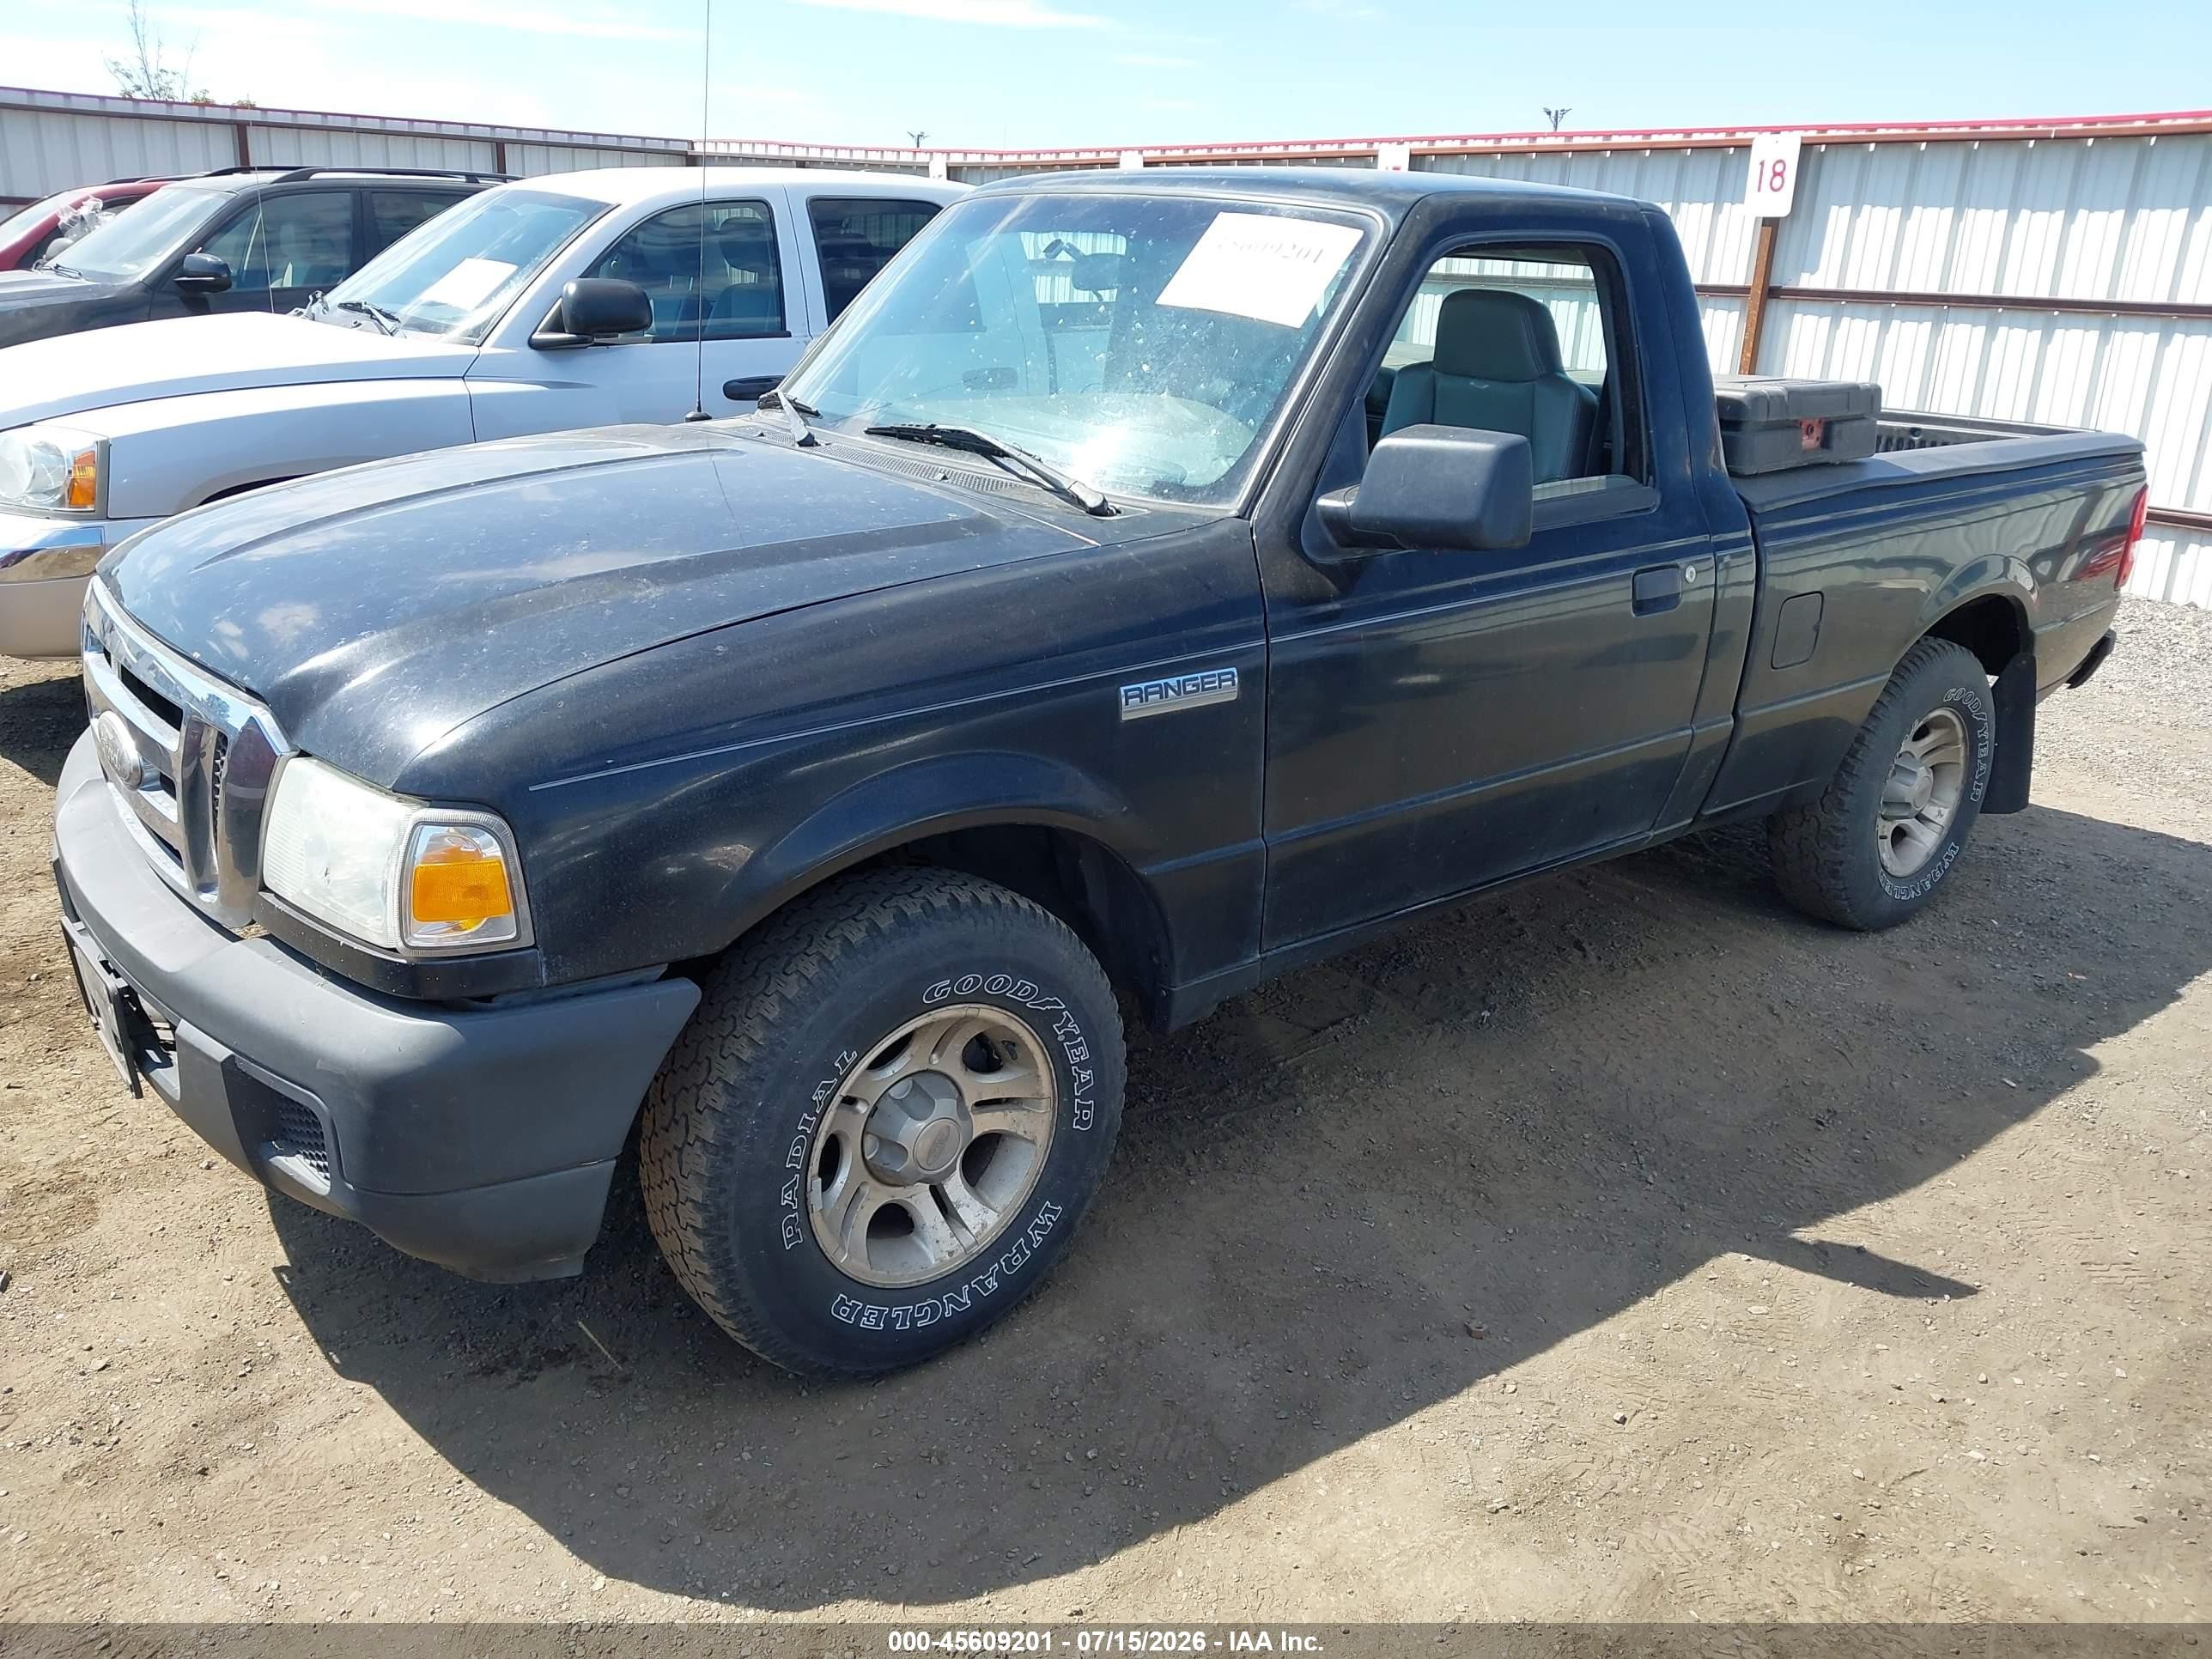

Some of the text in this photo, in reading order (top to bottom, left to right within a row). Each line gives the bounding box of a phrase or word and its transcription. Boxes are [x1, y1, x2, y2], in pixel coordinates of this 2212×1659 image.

[1757, 159, 1787, 193] 18
[1123, 671, 1237, 707] RANGER
[921, 973, 1095, 1133] GOODYEAR
[780, 1048, 859, 1250] RADIAL
[830, 1200, 1063, 1331] WRANGLER
